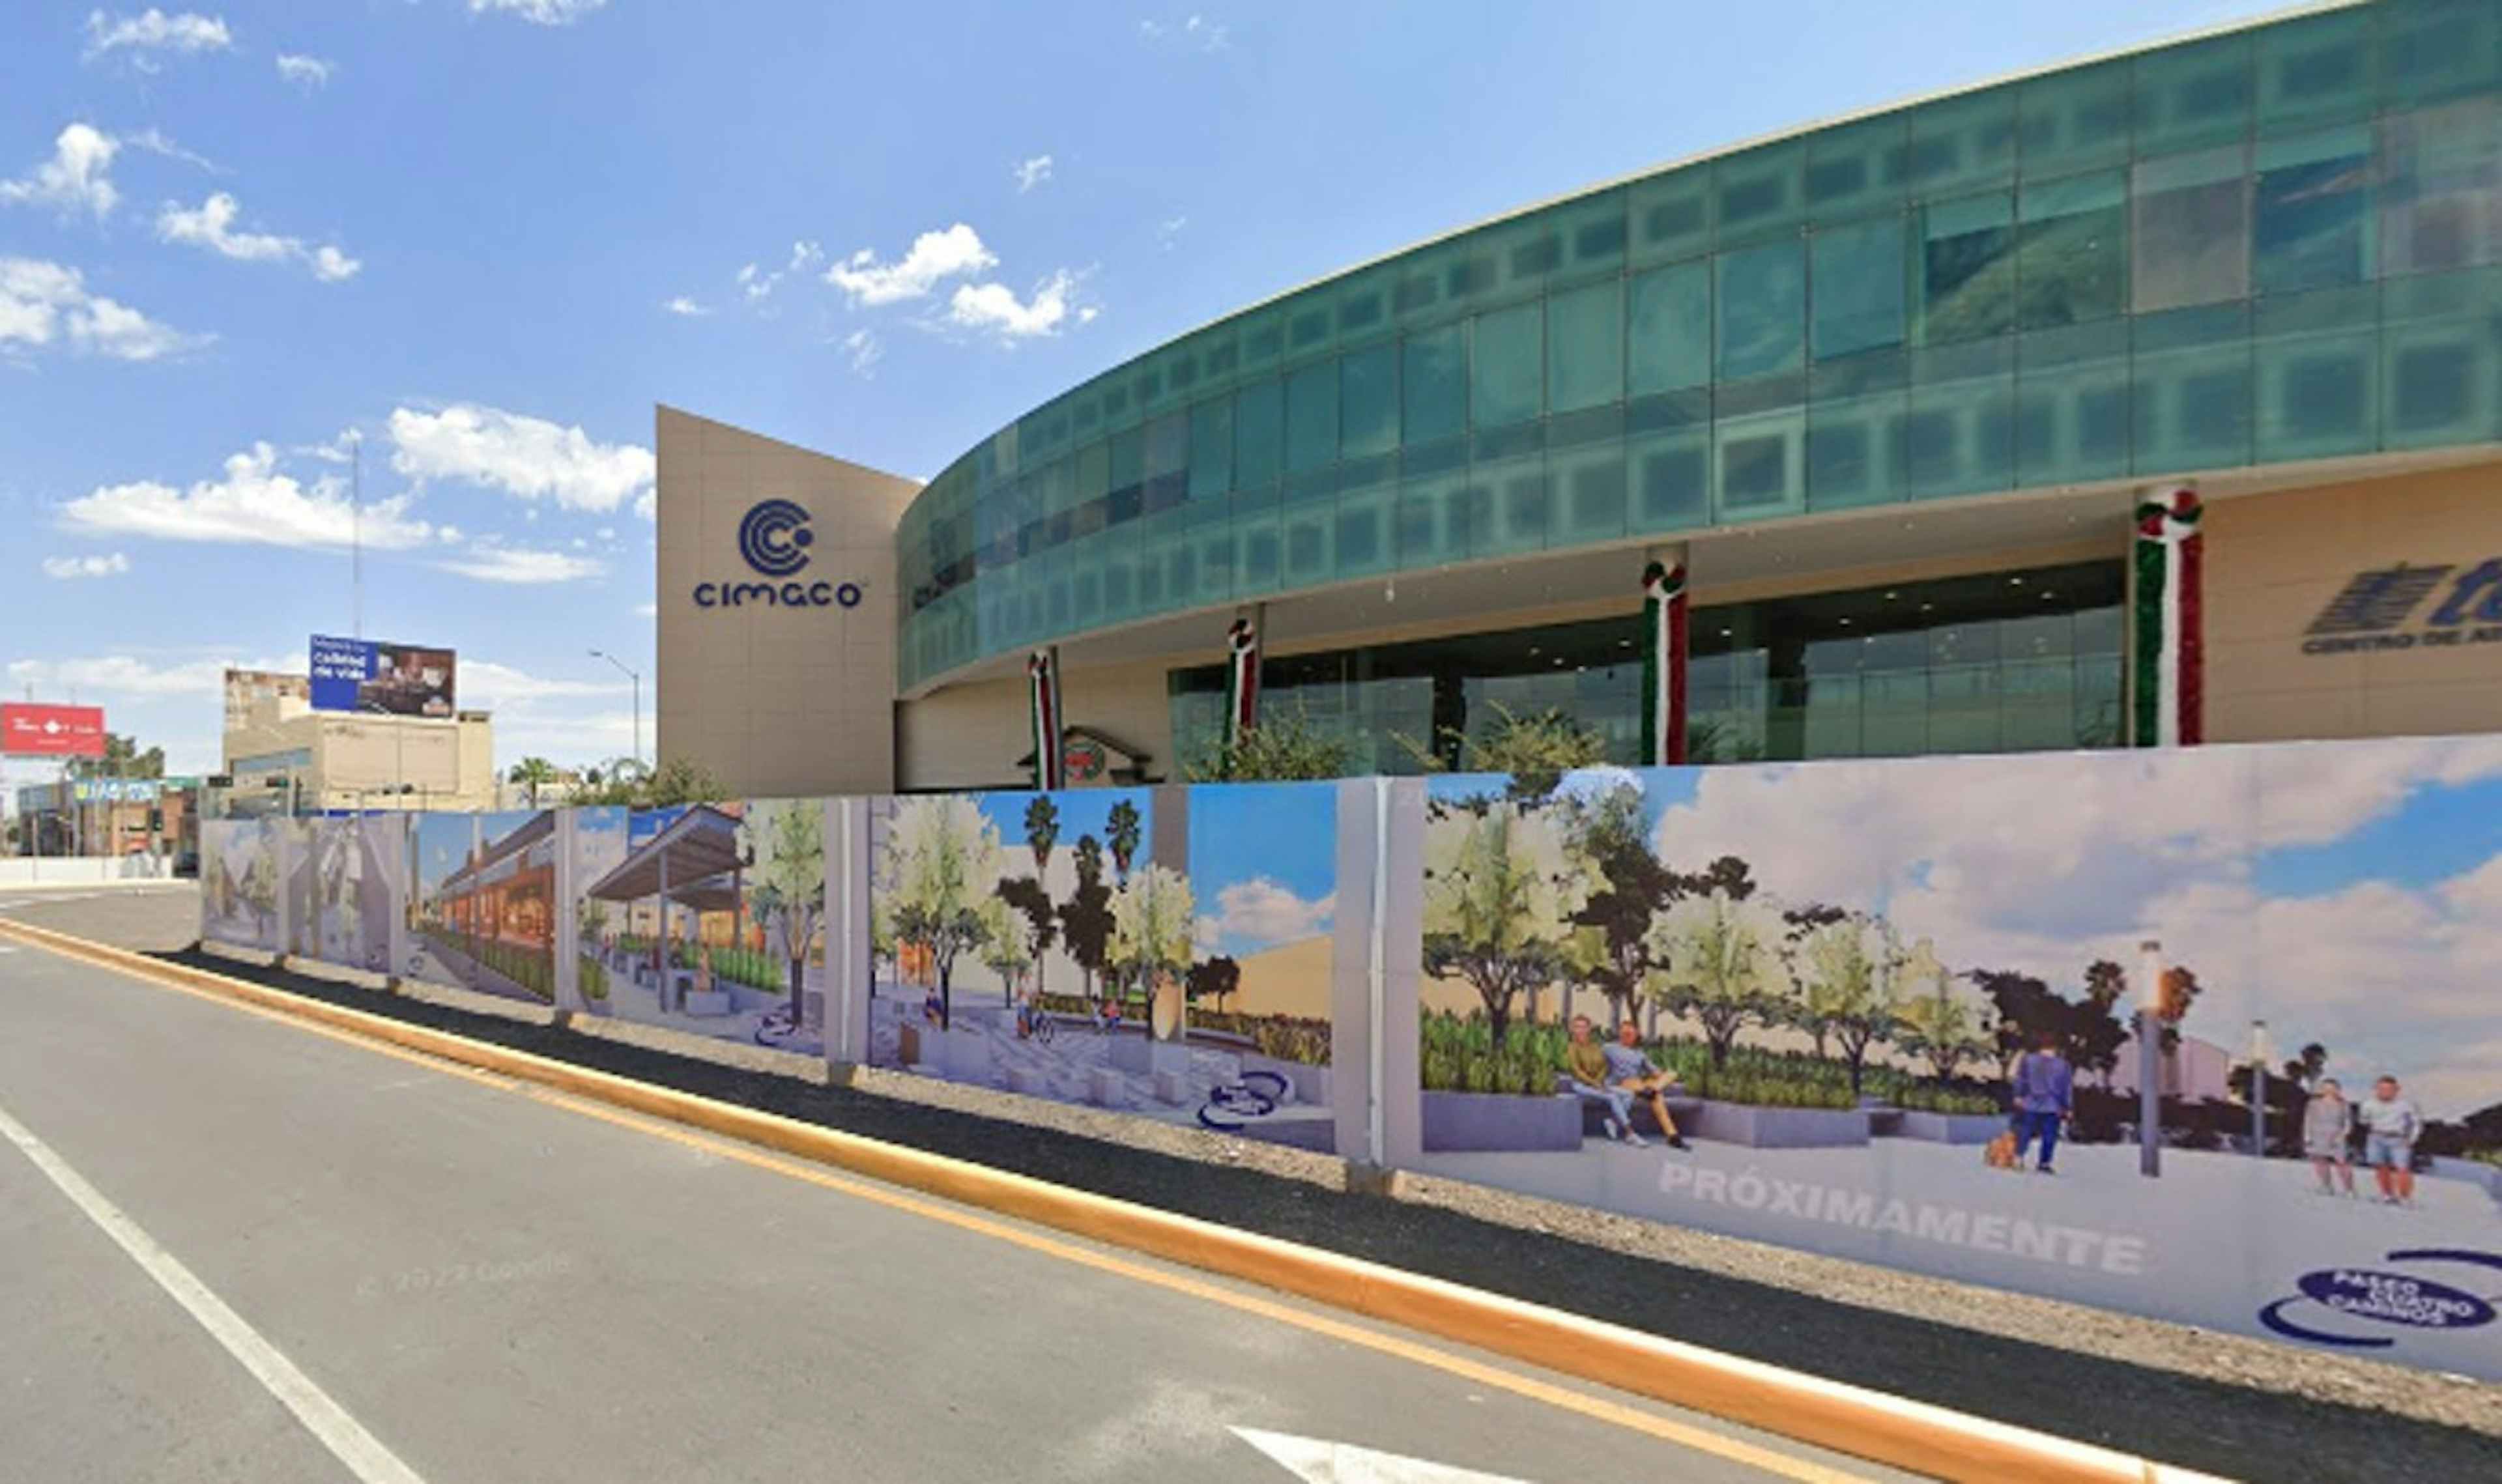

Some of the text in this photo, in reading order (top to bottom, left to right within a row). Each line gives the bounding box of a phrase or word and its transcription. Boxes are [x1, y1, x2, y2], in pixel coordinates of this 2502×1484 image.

[2302, 633, 2416, 655] CENTRO
[2422, 630, 2462, 646] DE
[1659, 1163, 2148, 1275] PRÓXIMAMENTE
[2332, 1271, 2418, 1294] PASEO
[2325, 1294, 2445, 1325] CAMINOS
[2368, 1288, 2475, 1316] CUATRO
